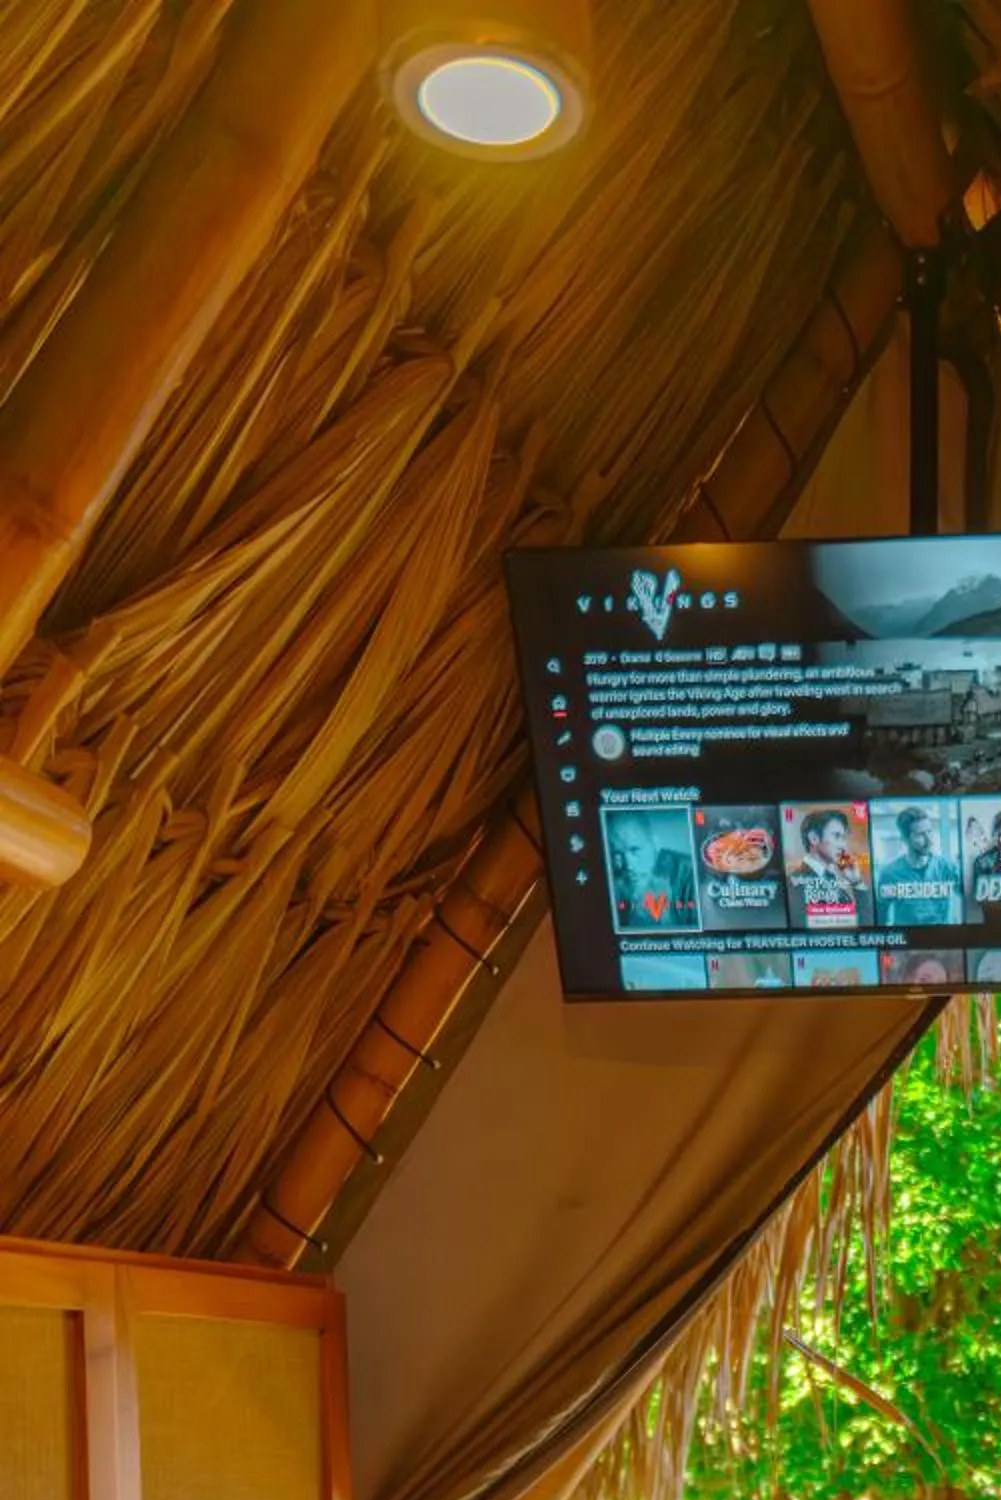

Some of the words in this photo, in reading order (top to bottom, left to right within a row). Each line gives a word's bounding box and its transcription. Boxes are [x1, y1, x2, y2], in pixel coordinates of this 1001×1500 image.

[586, 672, 628, 687] Hungry
[629, 671, 645, 684] for
[646, 672, 675, 684] more
[678, 670, 702, 682] than
[704, 669, 738, 684] simple
[742, 667, 803, 683] plundering,
[805, 668, 819, 679] an
[821, 665, 875, 678] ambitious
[589, 690, 627, 702] warrior
[629, 689, 666, 704] ignites
[667, 687, 685, 699] the
[687, 686, 722, 702] Viking
[723, 685, 745, 700] Age
[748, 685, 775, 697] after
[776, 684, 823, 699] traveling
[824, 684, 850, 695] west
[853, 683, 863, 694] in
[865, 682, 902, 694] search
[591, 706, 604, 719] of
[605, 705, 667, 720] unexplored
[667, 704, 700, 719] lands,
[701, 704, 736, 718] power
[737, 702, 759, 715] and
[759, 701, 791, 716] glory.
[631, 727, 670, 743] Multiple
[672, 726, 702, 742] Emmy
[703, 727, 746, 739] nominee
[747, 726, 762, 738] for
[763, 725, 792, 737] visual
[793, 723, 826, 736] effects
[828, 723, 849, 736] and
[601, 787, 629, 803] Your
[631, 787, 659, 802] Next
[660, 785, 700, 801] Watch
[707, 876, 778, 900] Culinary
[897, 881, 955, 899] RESIDENT
[620, 940, 670, 952] Continue
[672, 939, 725, 953] Watching
[727, 938, 742, 950] for
[745, 938, 807, 949] TRAVELER
[809, 937, 856, 948] HOSTEL
[859, 936, 884, 947] SAN
